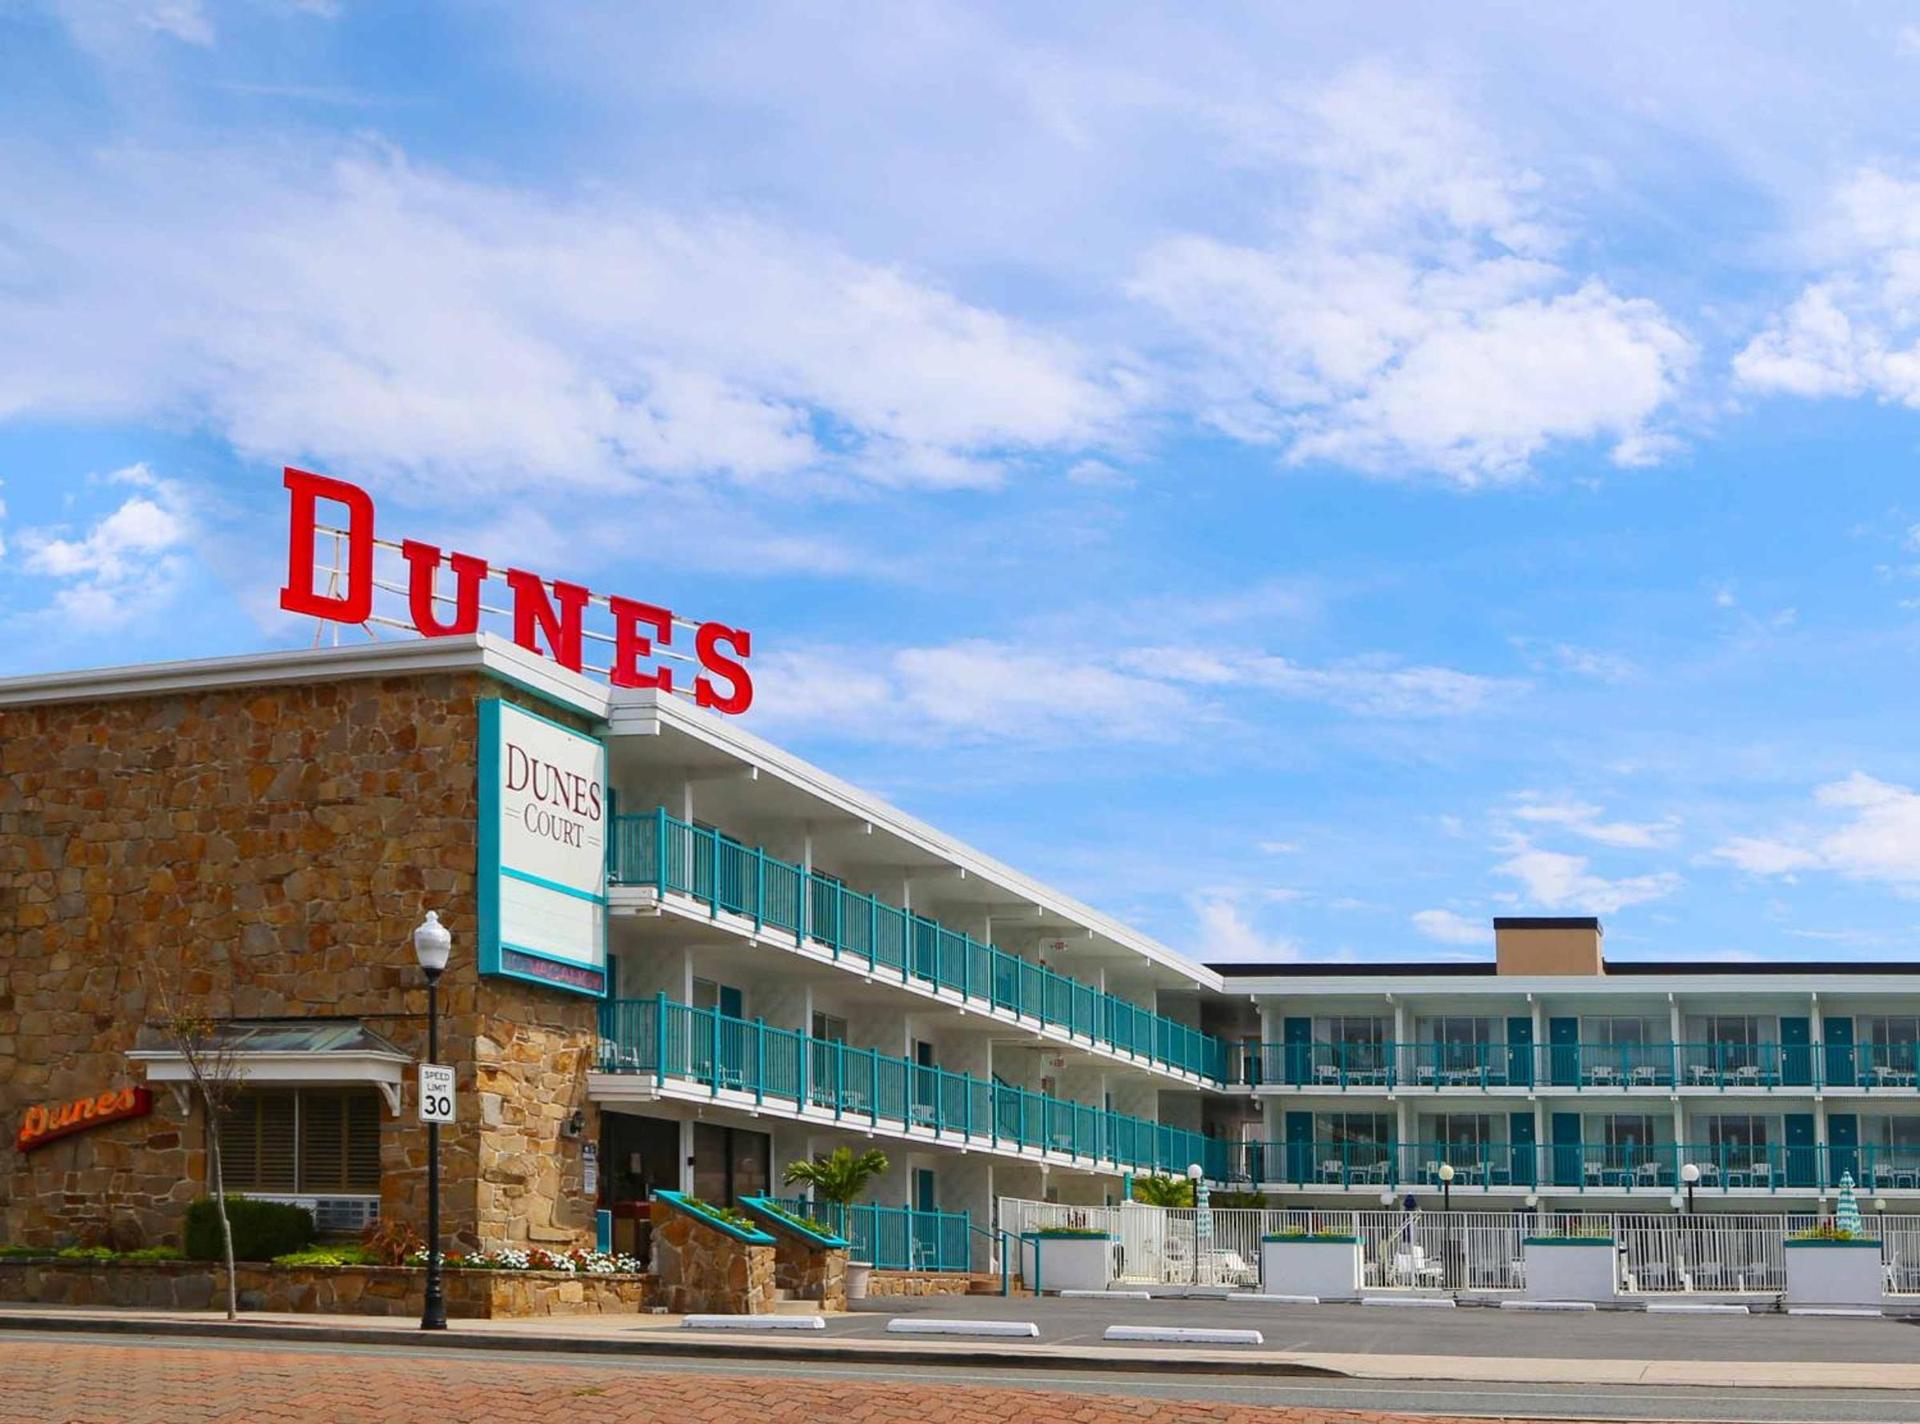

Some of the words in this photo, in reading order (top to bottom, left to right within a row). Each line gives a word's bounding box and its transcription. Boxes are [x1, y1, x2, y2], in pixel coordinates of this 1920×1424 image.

[280, 466, 753, 715] DUNES
[505, 742, 601, 821] DUNES
[524, 803, 584, 848] COURT
[424, 1071, 450, 1081] SPEED
[427, 1083, 447, 1093] LIMIT
[20, 1087, 135, 1140] Dunes
[424, 1095, 451, 1116] 30
